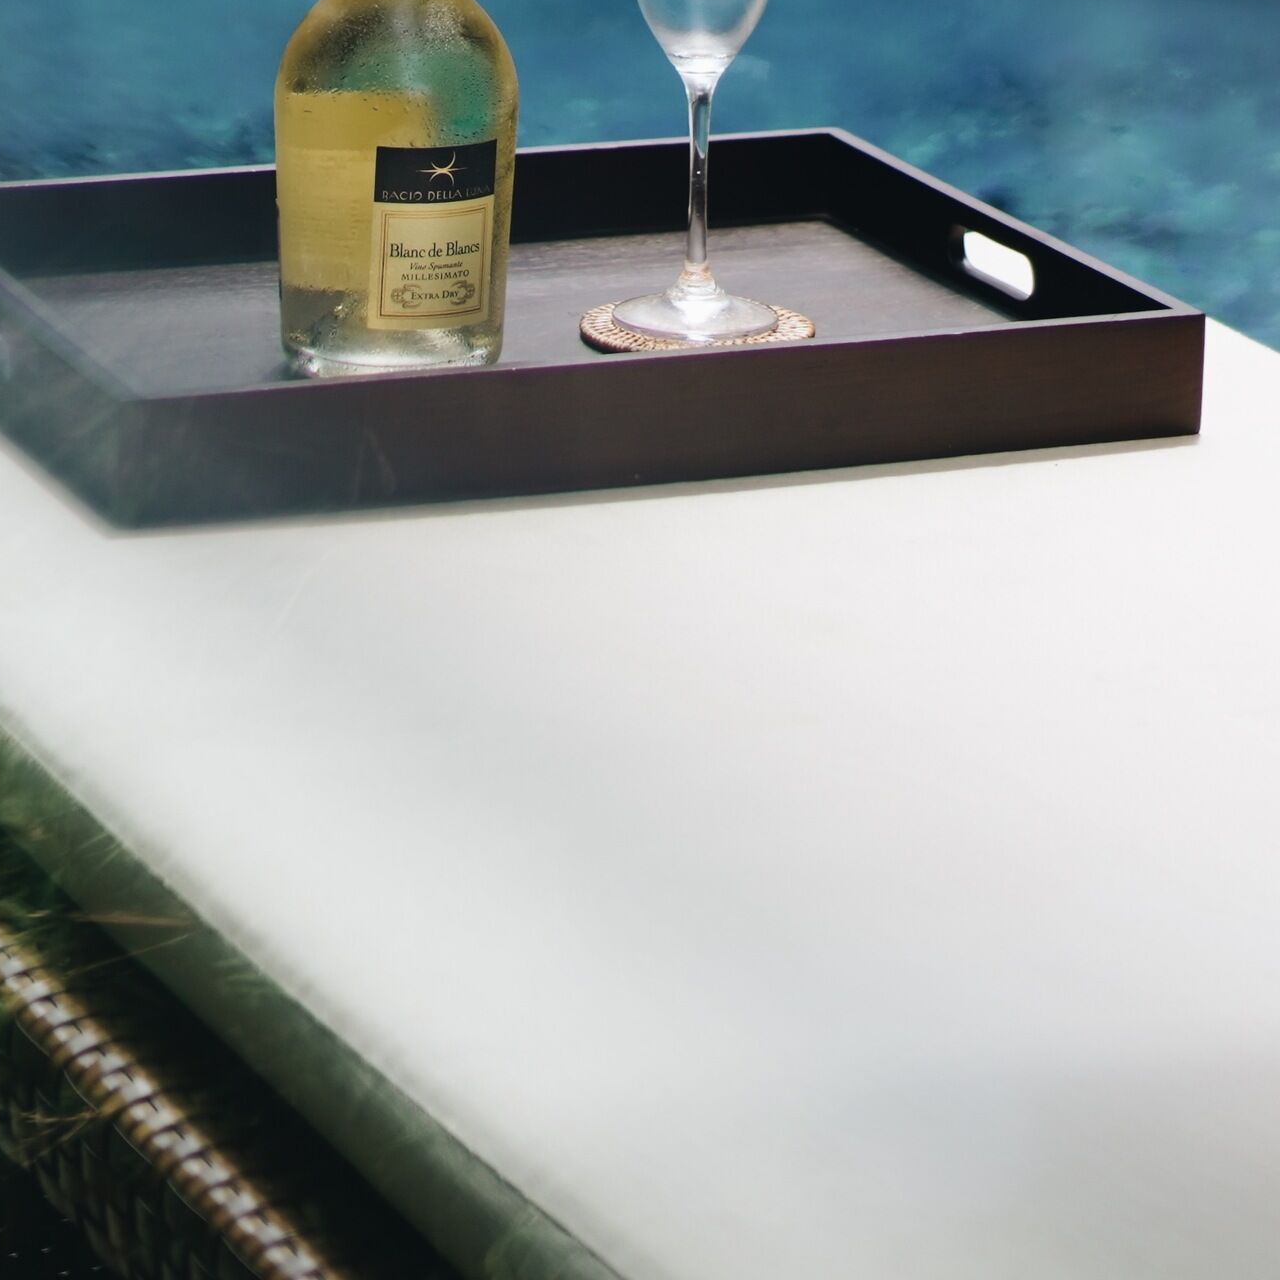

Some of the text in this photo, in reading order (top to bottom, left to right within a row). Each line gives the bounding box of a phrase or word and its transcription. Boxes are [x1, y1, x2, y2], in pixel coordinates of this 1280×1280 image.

[382, 190, 423, 201] BACIO
[427, 189, 462, 201] DELLA
[389, 240, 480, 258] Blanc de Blancs
[410, 261, 463, 271] Vino Spumante
[401, 270, 470, 281] MILLESIMATO
